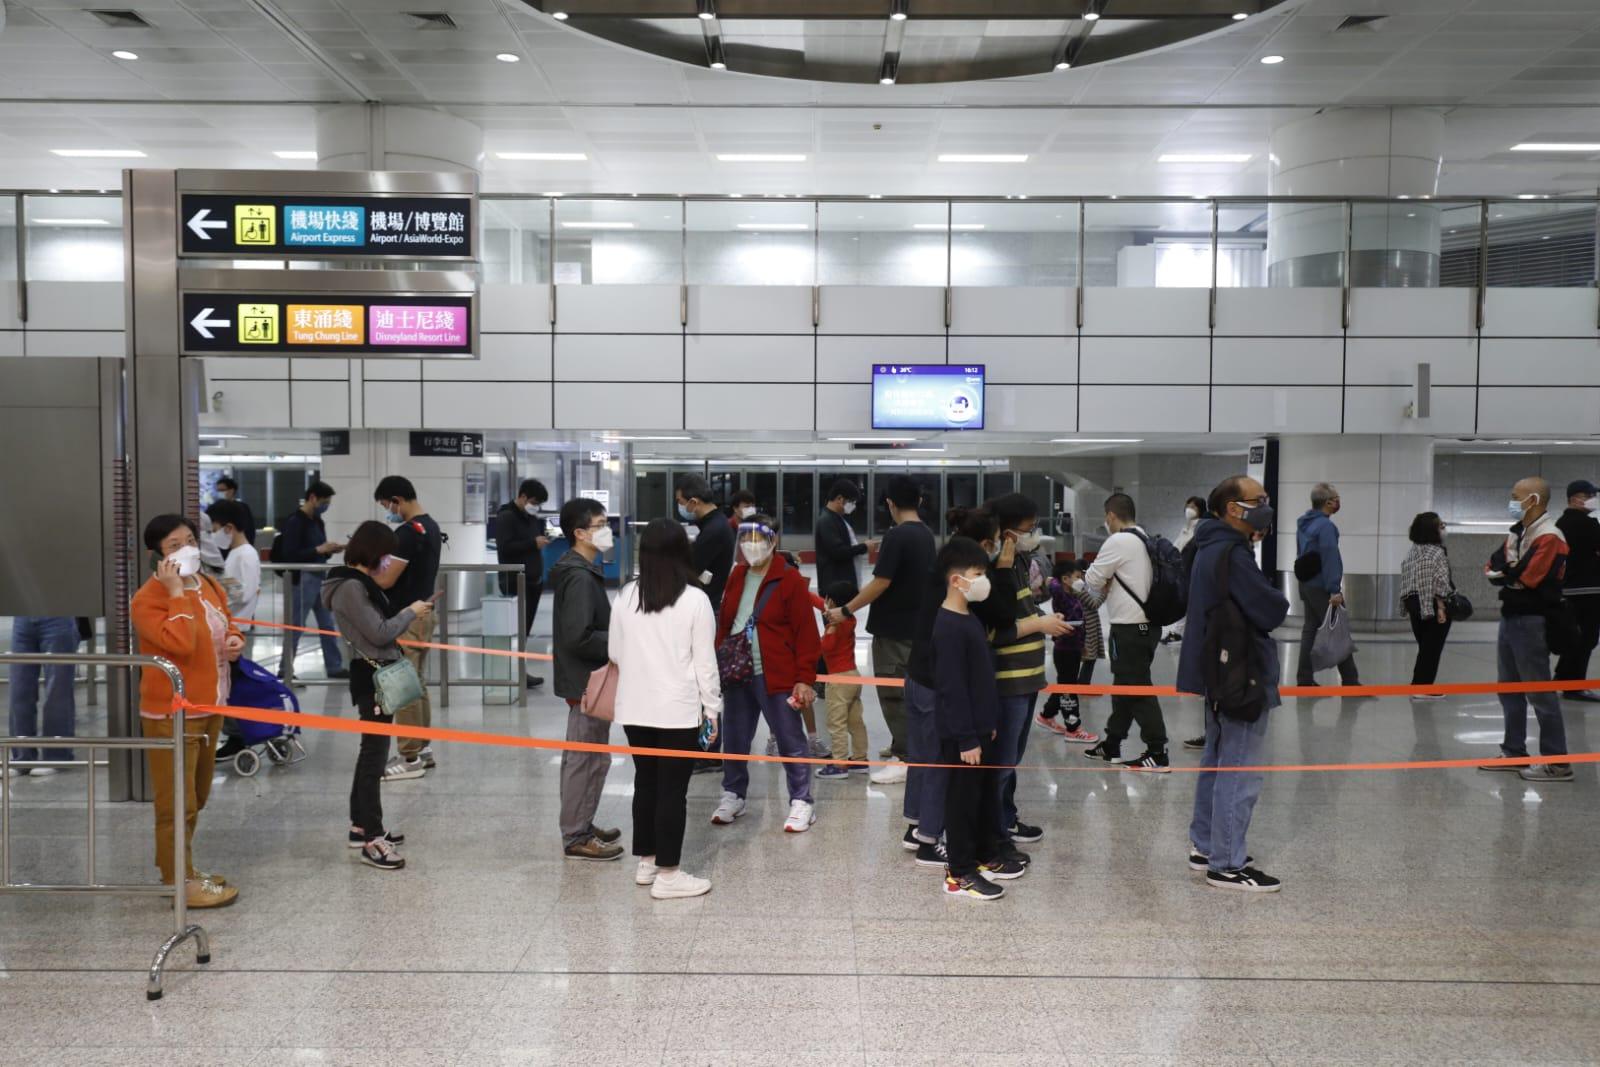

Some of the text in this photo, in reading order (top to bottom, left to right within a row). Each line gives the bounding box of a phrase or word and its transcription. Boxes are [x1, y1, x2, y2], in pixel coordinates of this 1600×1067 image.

[291, 210, 358, 230] 機場快綫
[290, 233, 356, 244] Airport Express
[370, 233, 398, 245] Airport
[403, 234, 464, 245] AsiaWorld-Expo
[295, 310, 352, 328] 東涌綫
[375, 310, 455, 330] 迪士尼綫
[294, 331, 358, 342] Tung Chung Line
[376, 332, 460, 343] Disneyland Resort Line
